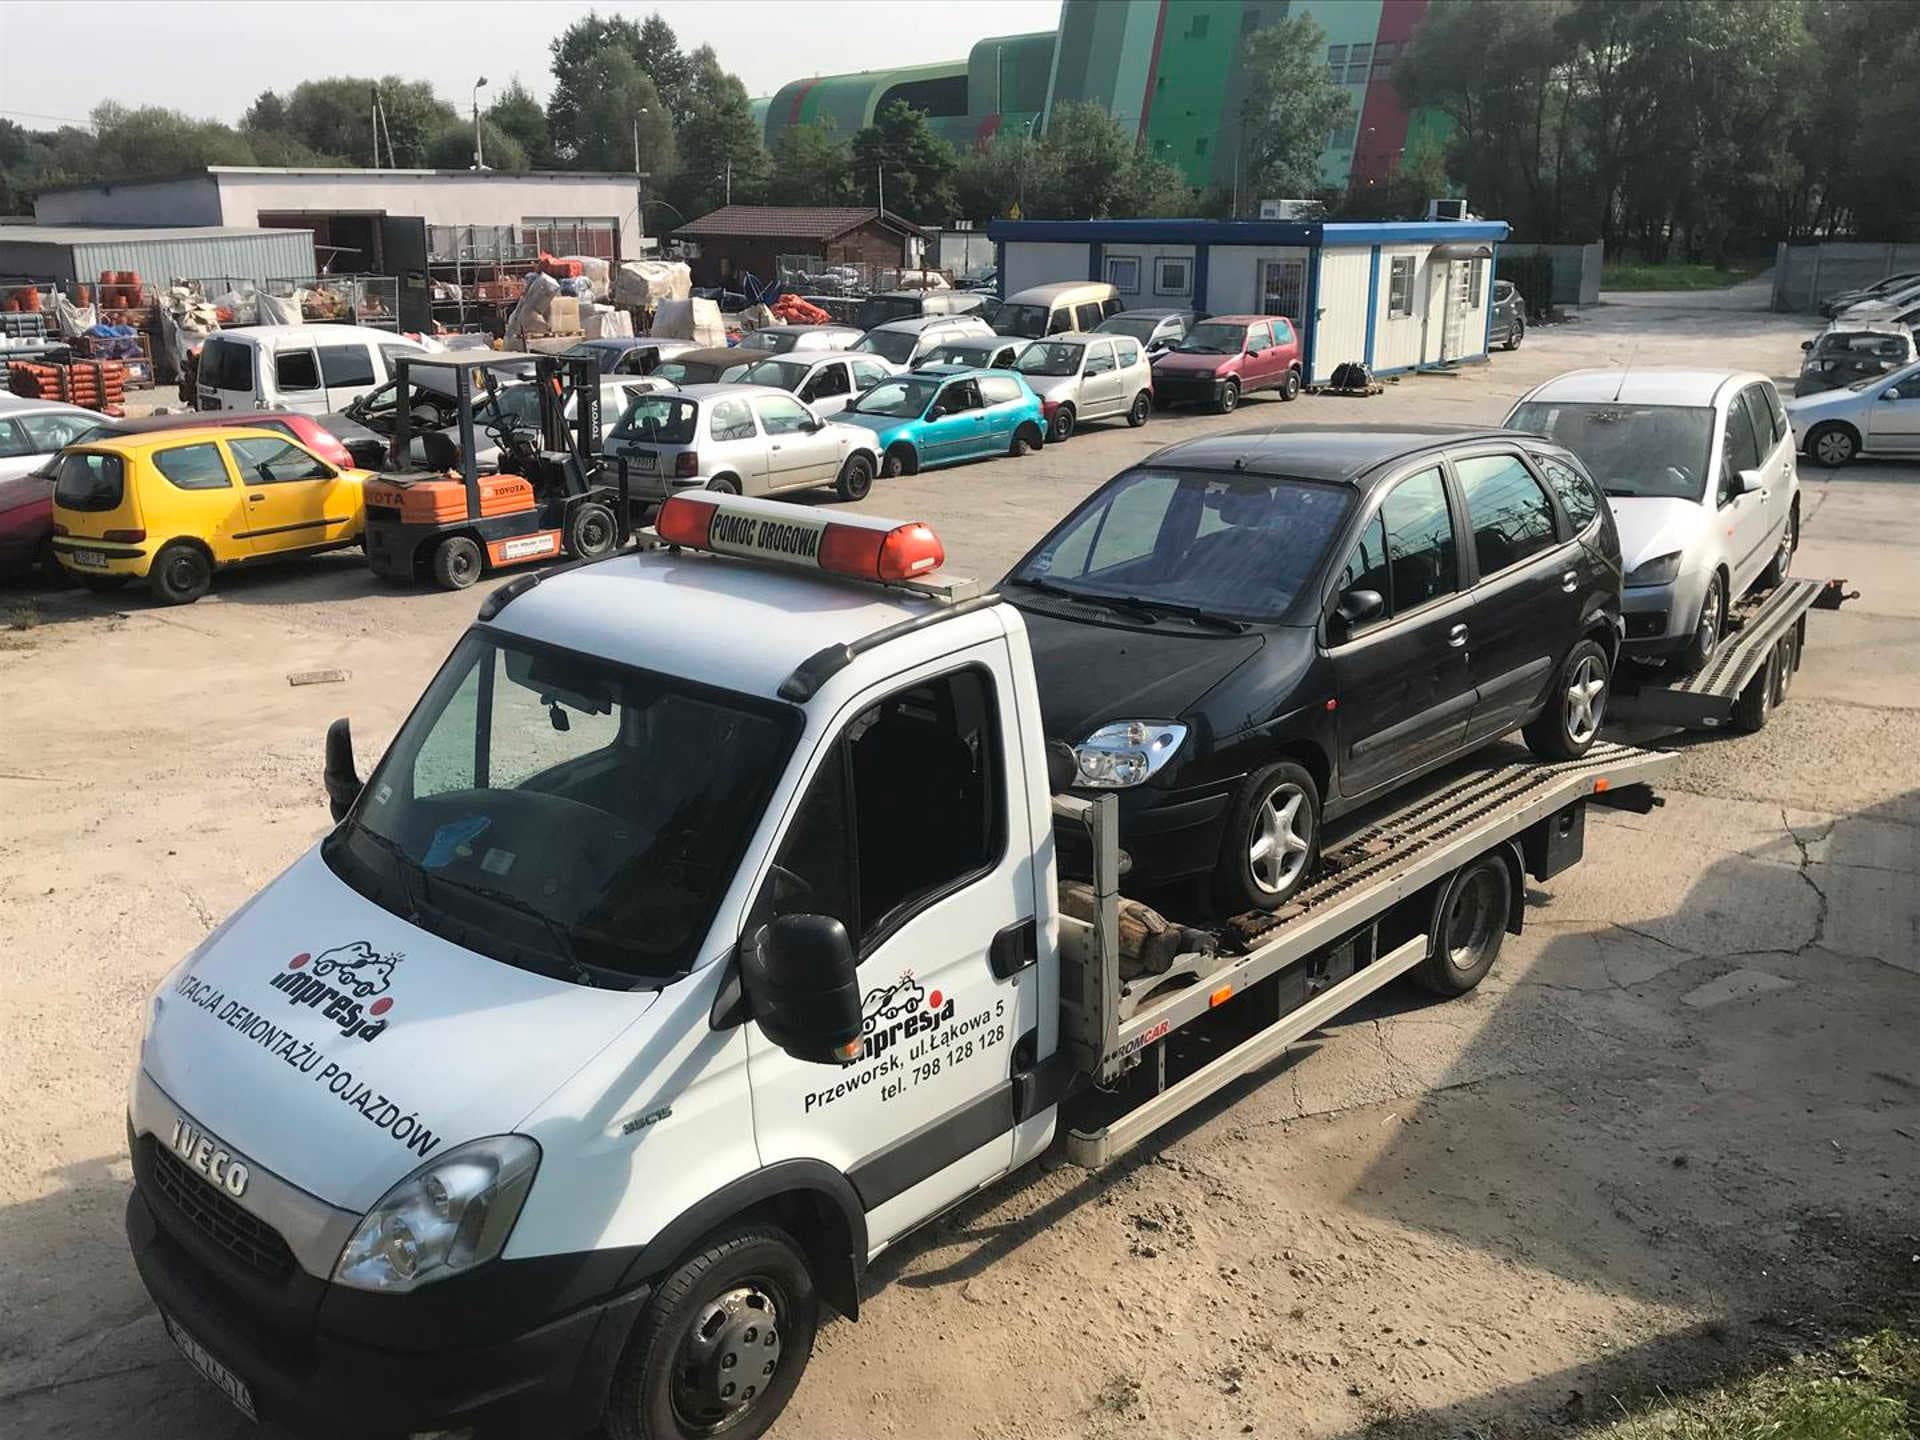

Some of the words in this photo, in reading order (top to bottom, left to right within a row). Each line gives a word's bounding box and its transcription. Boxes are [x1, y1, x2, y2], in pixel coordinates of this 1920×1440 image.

[494, 484, 525, 497] TOYOTA
[711, 514, 757, 546] POMOC
[757, 521, 819, 558] DROGOWA
[270, 954, 393, 1042] impresja
[217, 1001, 324, 1073] DEMONTAŻU
[315, 1063, 441, 1158] POJAZDÓW
[804, 1055, 904, 1113] Przeworsk,
[995, 1000, 1004, 1017] 5
[881, 1077, 907, 1101] tel.
[912, 1059, 941, 1085] 798
[946, 1041, 973, 1066] 128
[978, 1025, 1005, 1050] 128
[172, 1116, 249, 1197] IVECO
